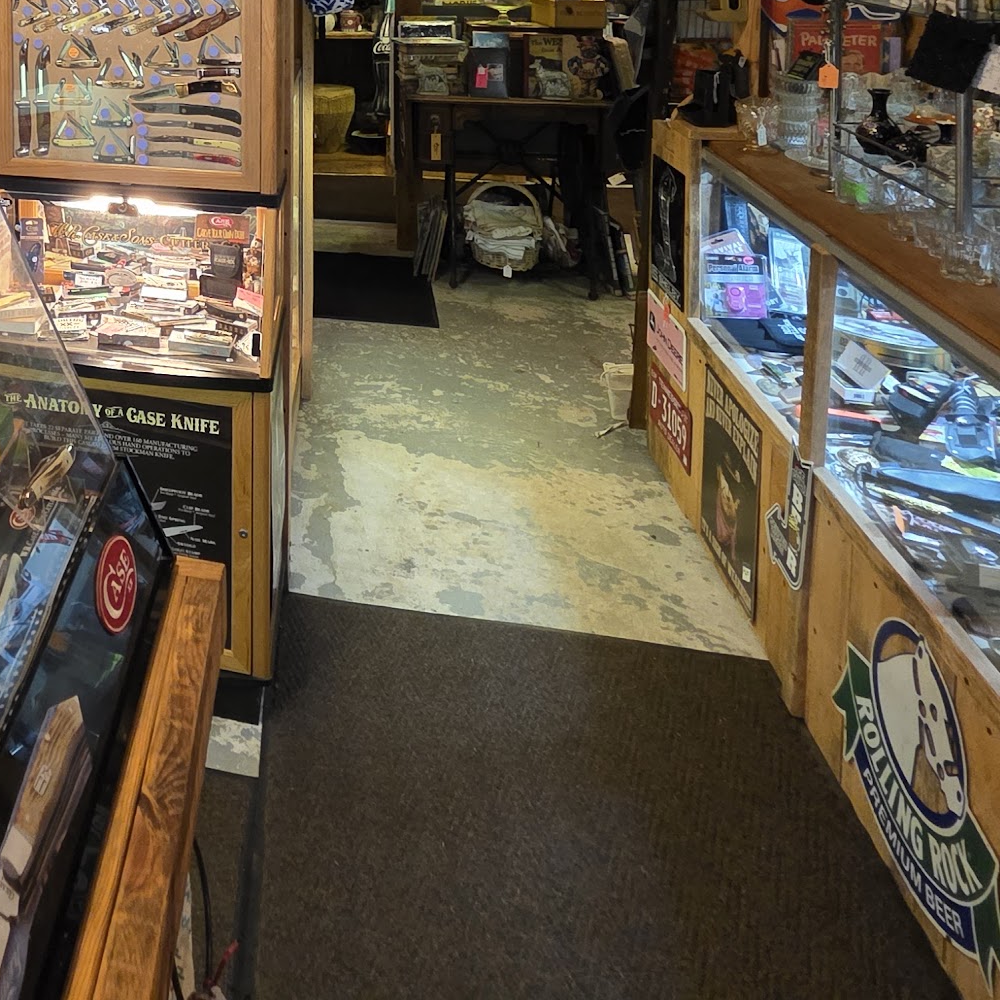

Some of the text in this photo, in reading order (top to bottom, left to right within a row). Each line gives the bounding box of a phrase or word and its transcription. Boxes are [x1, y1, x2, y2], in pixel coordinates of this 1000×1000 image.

[160, 234, 210, 250] CUTLER
[3, 393, 22, 404] THE
[105, 408, 117, 417] OF
[118, 408, 124, 417] A
[126, 407, 166, 428] CASE
[171, 413, 221, 435] KNIFE
[114, 434, 132, 443] OVER
[143, 438, 198, 452] MANUFACTURING
[117, 446, 153, 458] STOCKMAN
[122, 441, 141, 450] HAND
[142, 443, 181, 456] OPERATIONS
[104, 549, 134, 620] CASE
[856, 695, 984, 896] ROLLING ROCK
[863, 767, 965, 939] PREMIUM BEER
